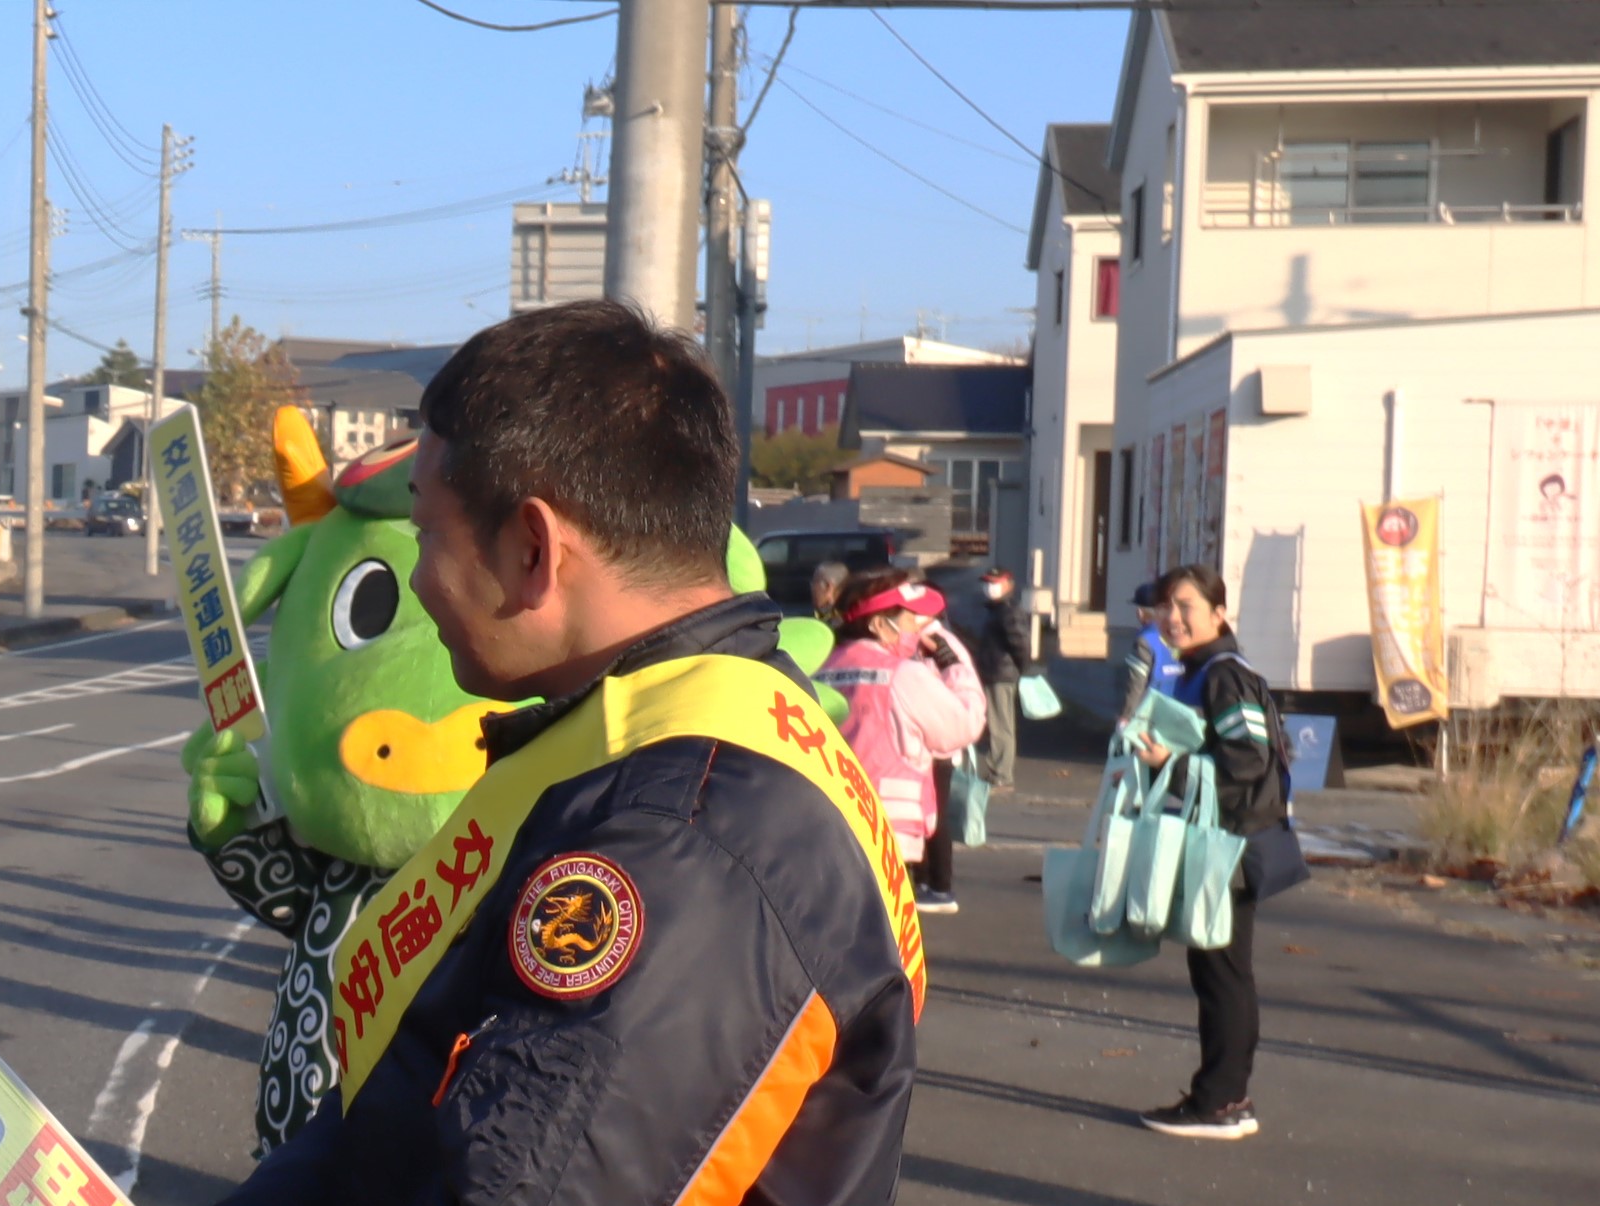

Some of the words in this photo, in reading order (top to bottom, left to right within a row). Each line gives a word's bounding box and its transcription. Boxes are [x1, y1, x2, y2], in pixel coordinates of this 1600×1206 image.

[161, 434, 233, 669] 交通安全運動
[525, 879, 546, 905] THE
[550, 862, 622, 894] RYUGASAKI
[618, 899, 634, 934] CITY
[516, 916, 538, 971] BRIGADE
[534, 970, 562, 987] FIRE
[565, 936, 630, 988] VOLUNTEER
